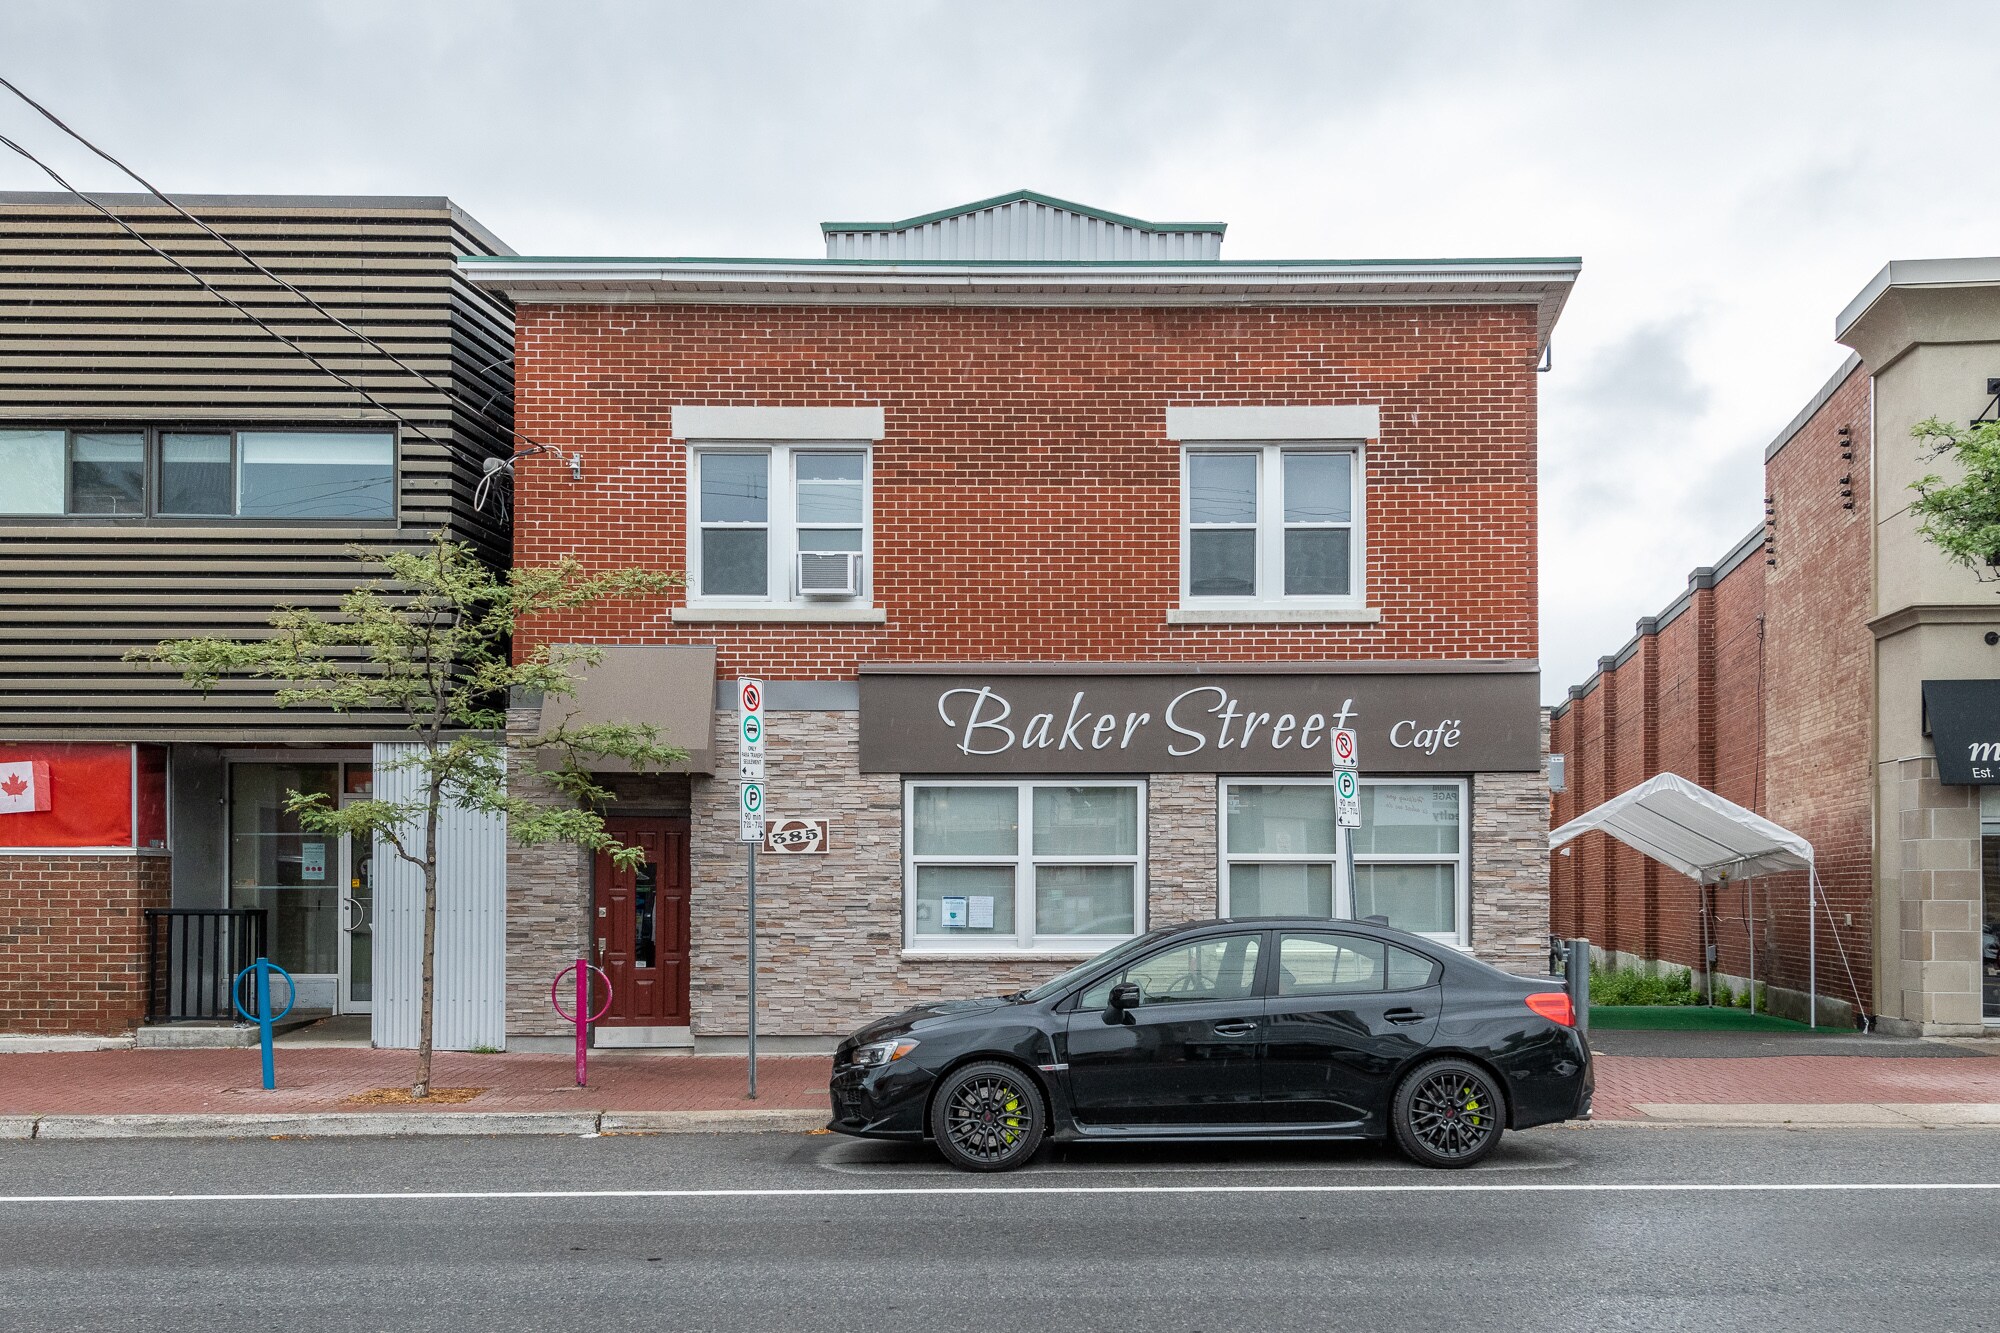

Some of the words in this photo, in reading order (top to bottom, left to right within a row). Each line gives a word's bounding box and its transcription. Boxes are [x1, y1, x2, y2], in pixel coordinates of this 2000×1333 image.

[938, 686, 1150, 755] Baker
[1165, 686, 1358, 756] Street
[1389, 719, 1461, 755] Café
[1972, 767, 1994, 778] Est.
[1343, 779, 1351, 792] P
[750, 792, 757, 805] P
[772, 829, 818, 844] 385
